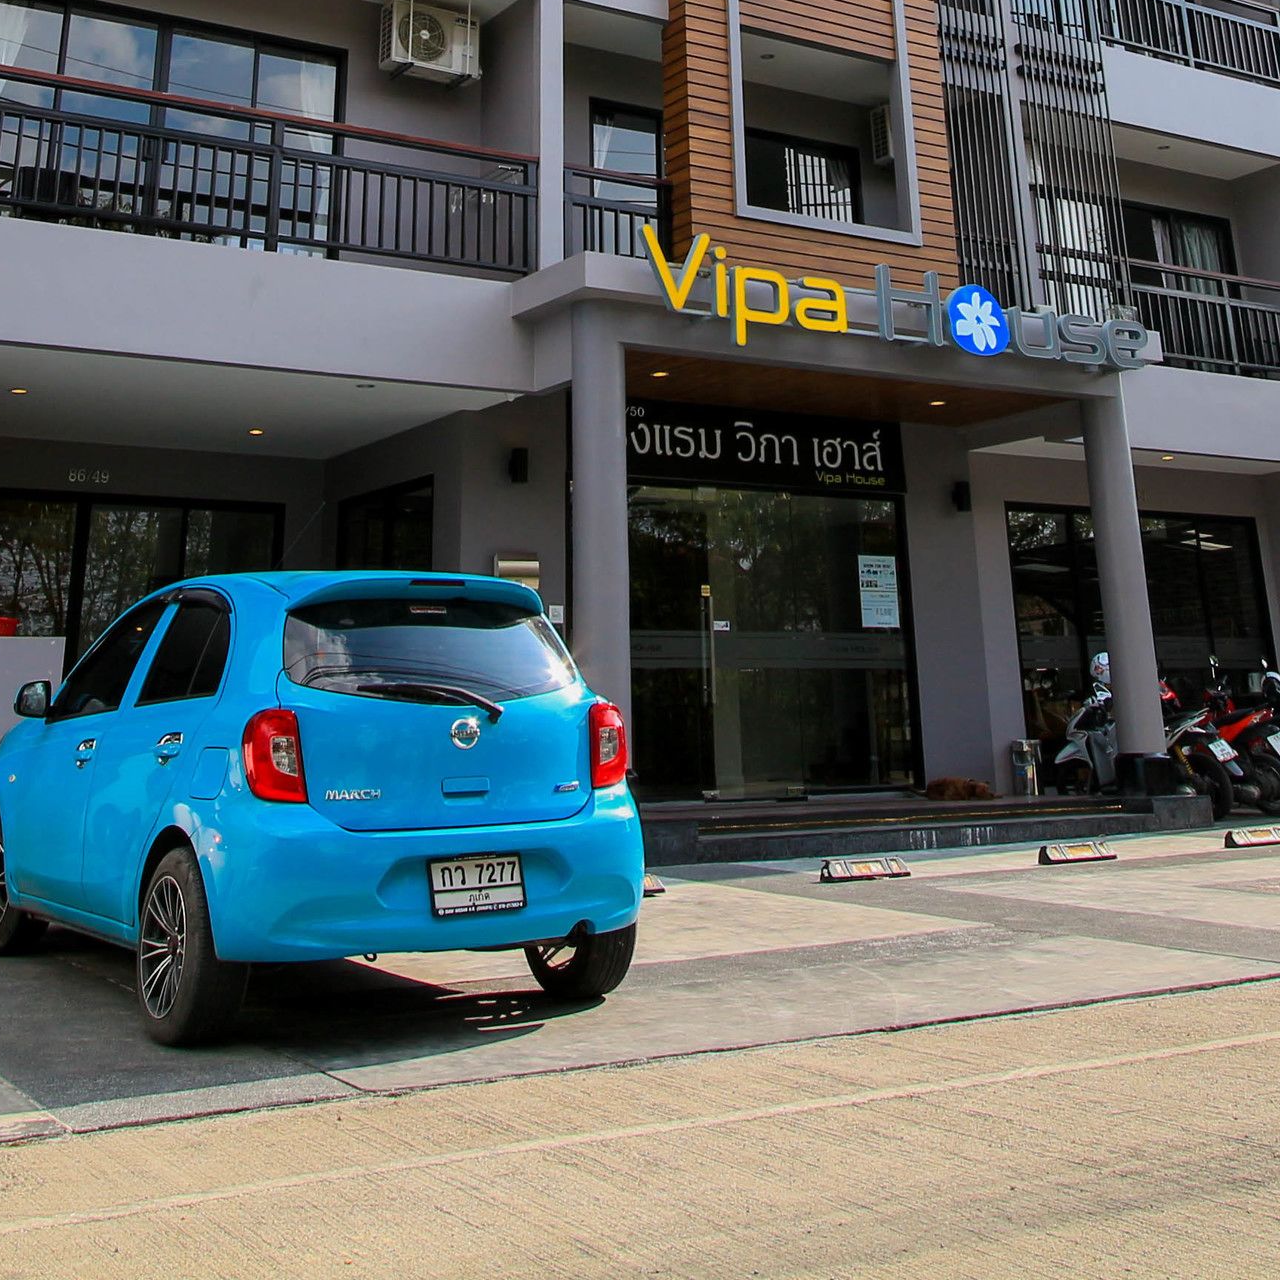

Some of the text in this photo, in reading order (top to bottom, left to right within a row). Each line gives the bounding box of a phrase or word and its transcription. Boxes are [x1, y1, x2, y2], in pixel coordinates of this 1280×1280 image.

[639, 223, 848, 346] Vipa
[625, 406, 645, 417] /50
[630, 423, 722, 460] งแรม
[812, 429, 883, 471] เฮาส์
[816, 470, 886, 486] Vipa House
[325, 789, 381, 800] MARCH
[440, 861, 517, 887] กว 7277
